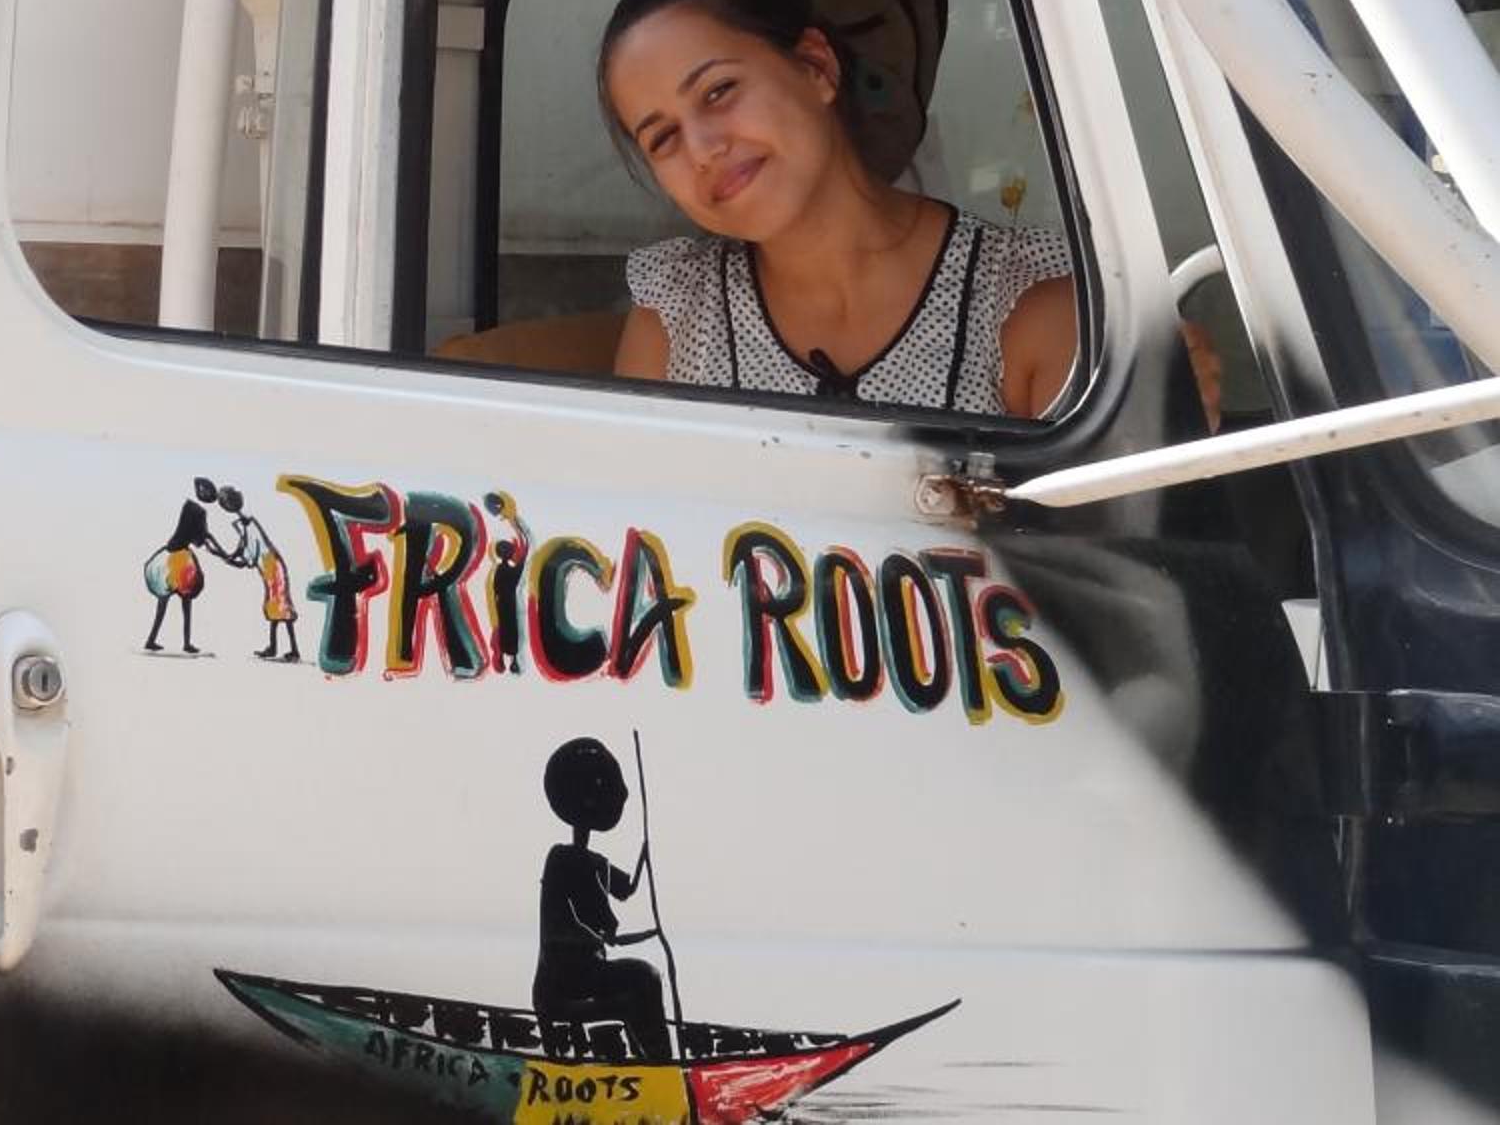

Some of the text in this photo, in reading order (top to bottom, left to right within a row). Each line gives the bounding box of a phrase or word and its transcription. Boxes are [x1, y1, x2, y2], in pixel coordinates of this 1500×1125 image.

[722, 520, 1066, 725] ROOTS
[365, 1030, 642, 1106] AFRICA ROOTS
